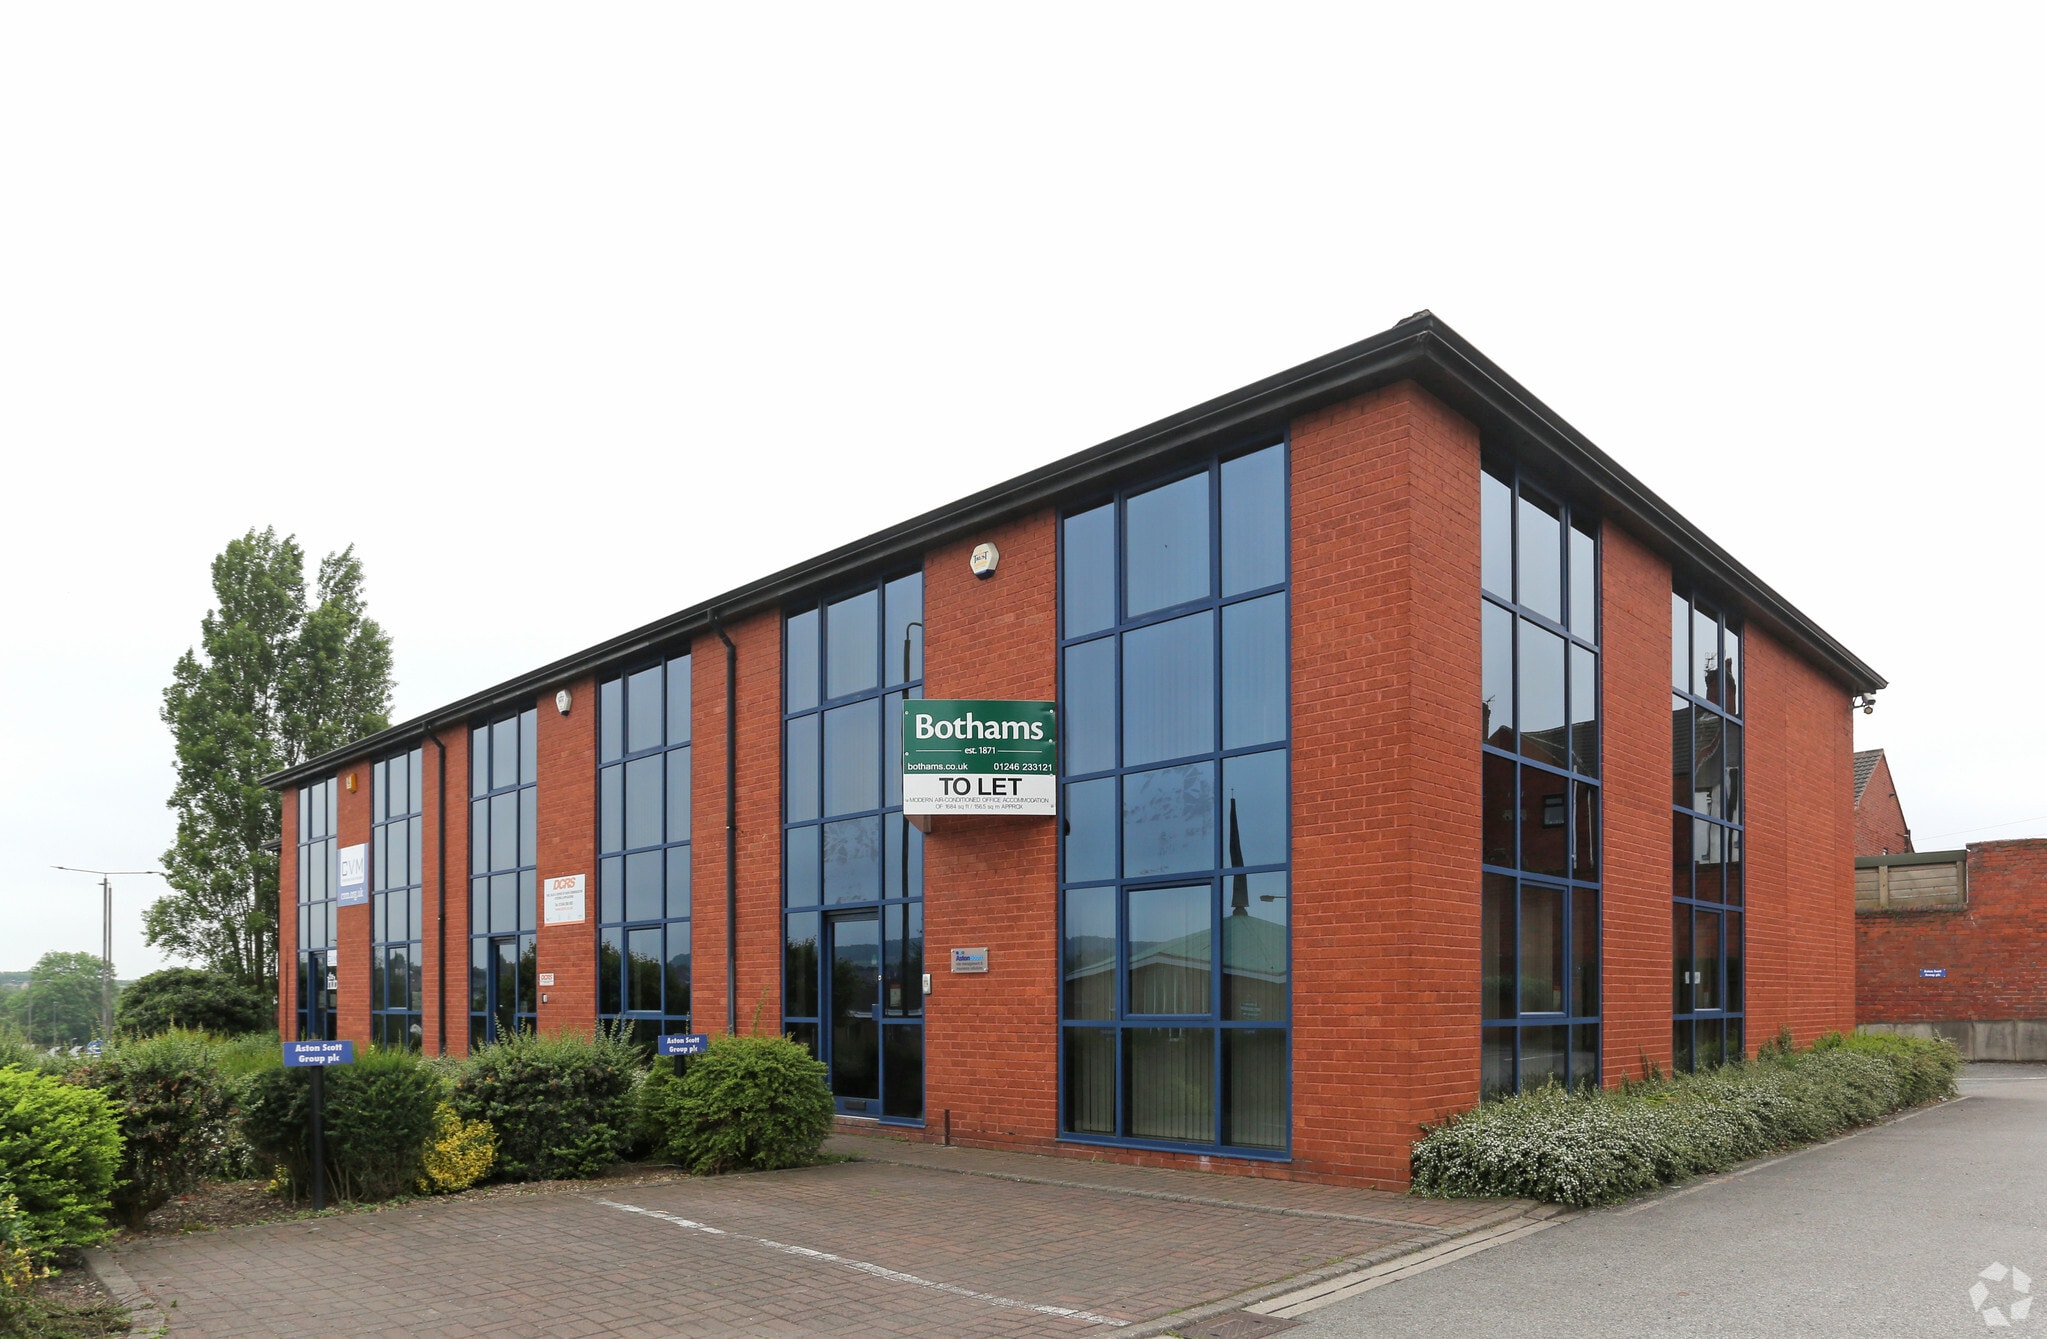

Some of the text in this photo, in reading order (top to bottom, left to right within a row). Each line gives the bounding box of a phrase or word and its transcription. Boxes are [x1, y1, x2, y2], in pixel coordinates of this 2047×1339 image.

[915, 712, 1044, 740] Bothams
[964, 746, 996, 754] est. 1871
[907, 762, 968, 770] bothams.co.uk
[993, 762, 1052, 771] 01246 233121
[939, 777, 1022, 796] TO LET
[342, 858, 364, 876] CVM
[553, 877, 576, 890] DCRS
[295, 1043, 343, 1052] Aston Scott
[669, 1046, 688, 1054] Group
[298, 1053, 340, 1064] Group plc
